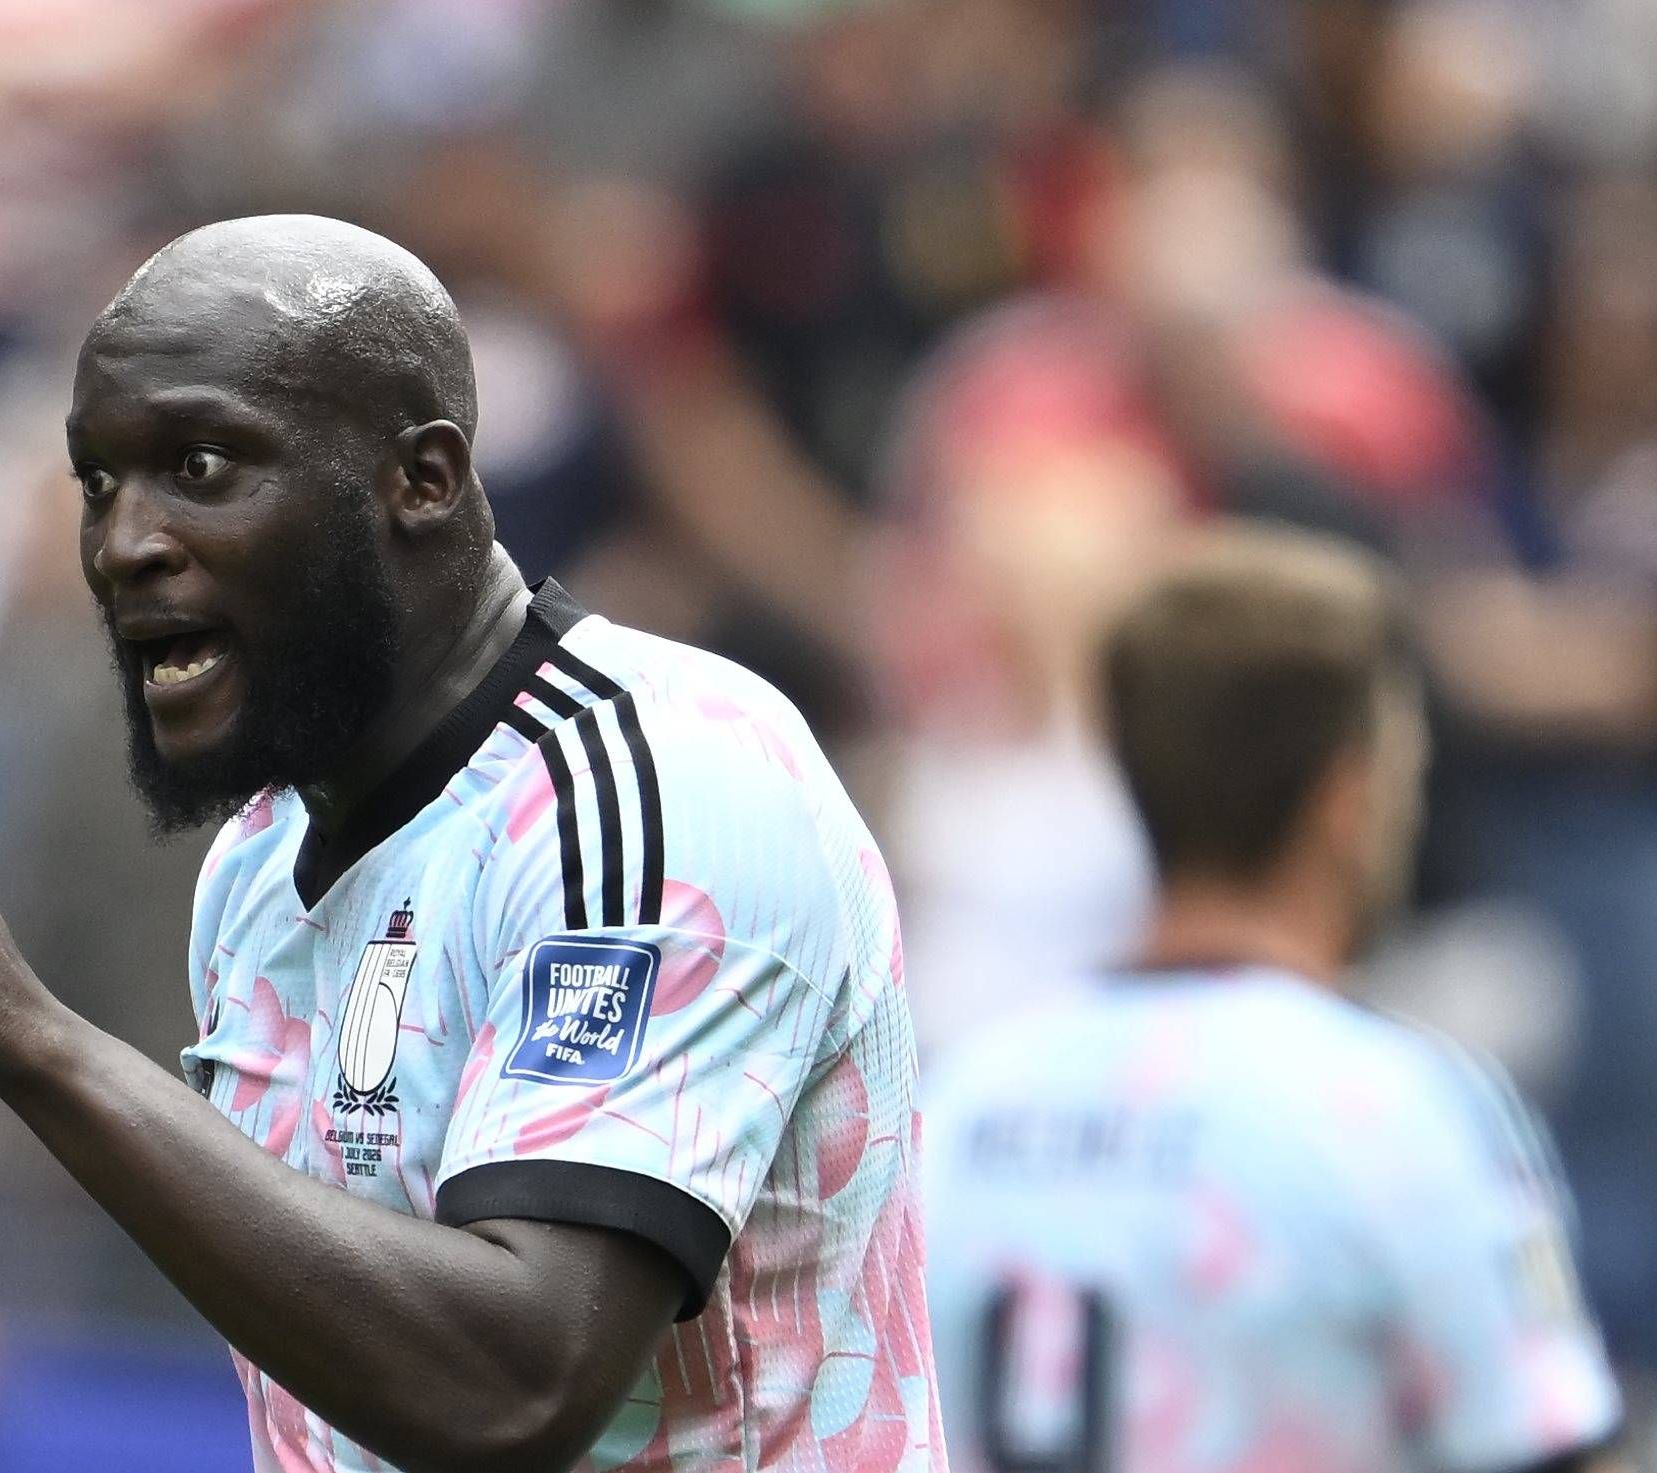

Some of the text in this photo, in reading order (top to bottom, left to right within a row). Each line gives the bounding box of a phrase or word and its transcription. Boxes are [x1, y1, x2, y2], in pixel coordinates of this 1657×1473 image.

[549, 962, 631, 990] FOOTBALL
[547, 986, 627, 1024] UNITES
[558, 1015, 626, 1056] World
[545, 1042, 584, 1065] FIFA
[324, 1129, 401, 1147] BELGIUM VS SENEGAL
[345, 1146, 361, 1160] JULY
[362, 1148, 382, 1162] 2026
[346, 1162, 378, 1178] SEATTLE
